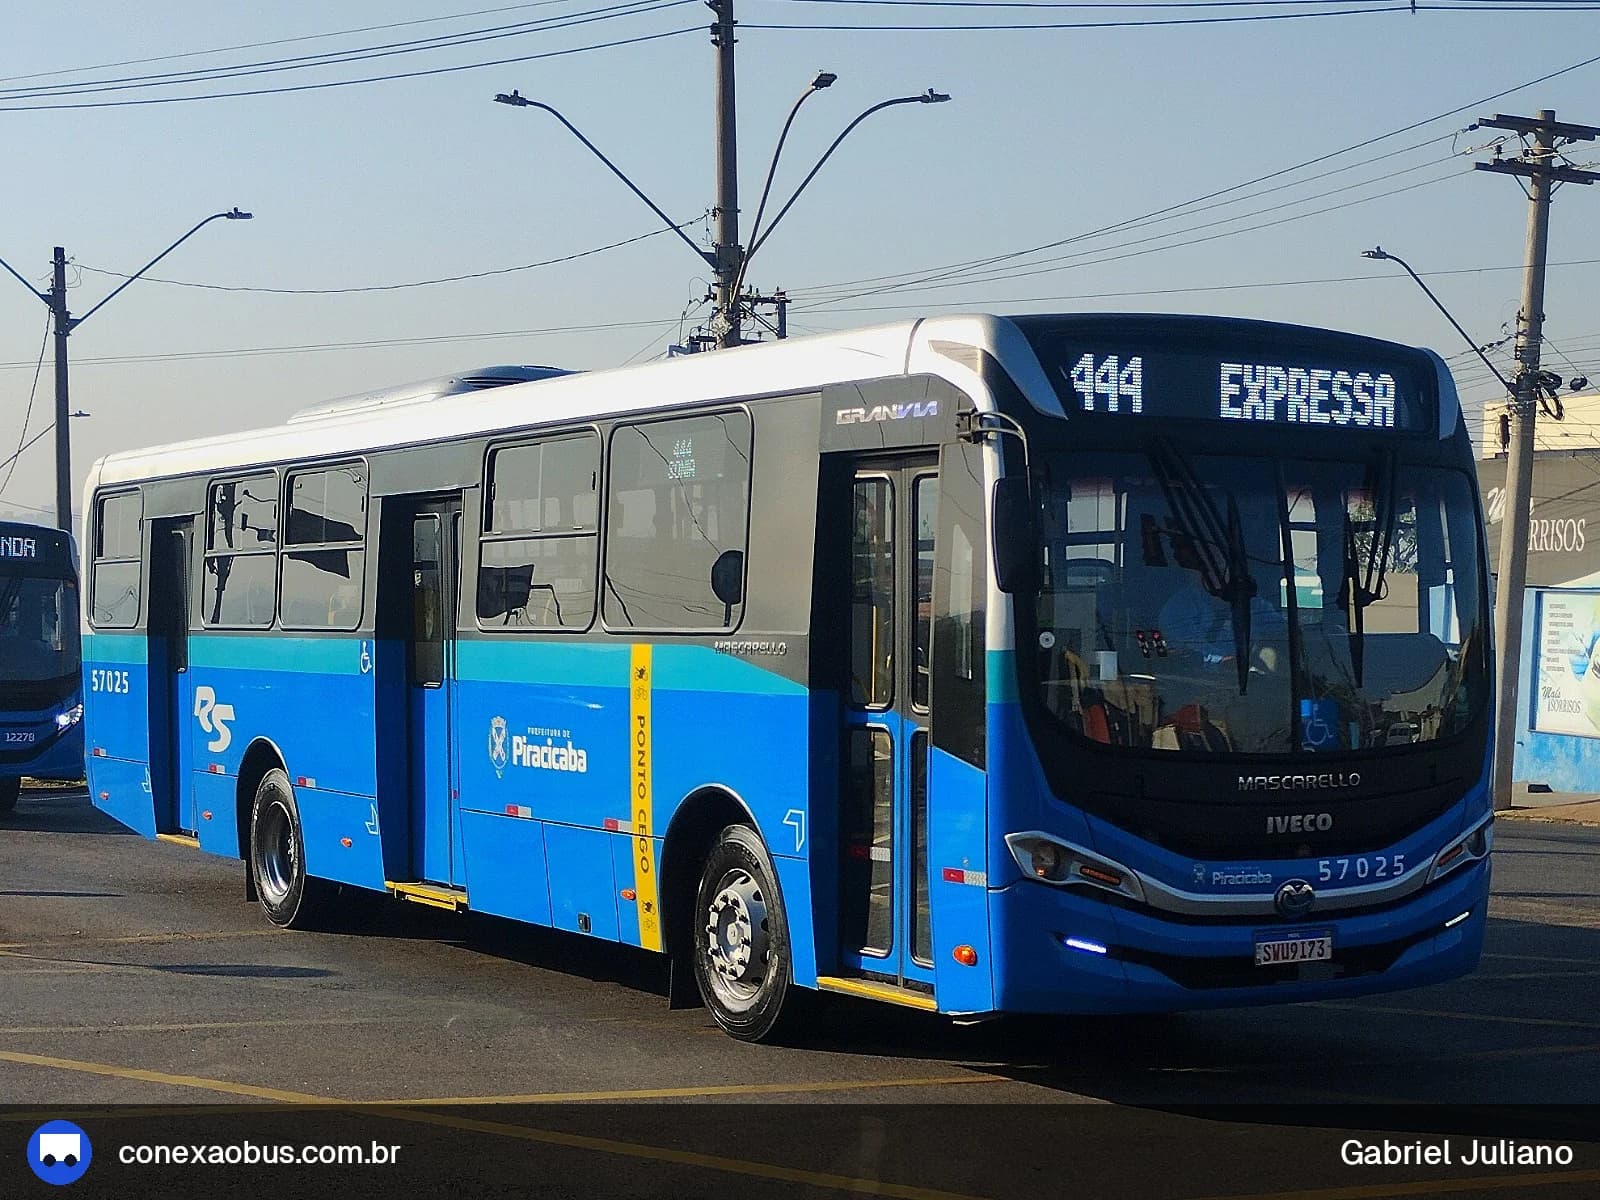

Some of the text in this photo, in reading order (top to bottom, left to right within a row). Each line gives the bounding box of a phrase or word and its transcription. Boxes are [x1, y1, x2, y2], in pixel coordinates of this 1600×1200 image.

[1070, 353, 1396, 427] 444 EXPRESSA
[1528, 518, 1586, 552] RRISOS
[714, 640, 787, 656] MASCARELLO
[91, 669, 129, 694] 57025
[193, 686, 235, 753] RS
[527, 726, 571, 739] PREFEITURA DE
[512, 735, 587, 773] Piracicaba
[637, 715, 650, 874] PONTO CEGO
[1237, 772, 1362, 792] MASCARELLO
[1266, 813, 1333, 835] IVECO
[1212, 870, 1272, 885] Piracicaba
[1318, 854, 1405, 882] 57025
